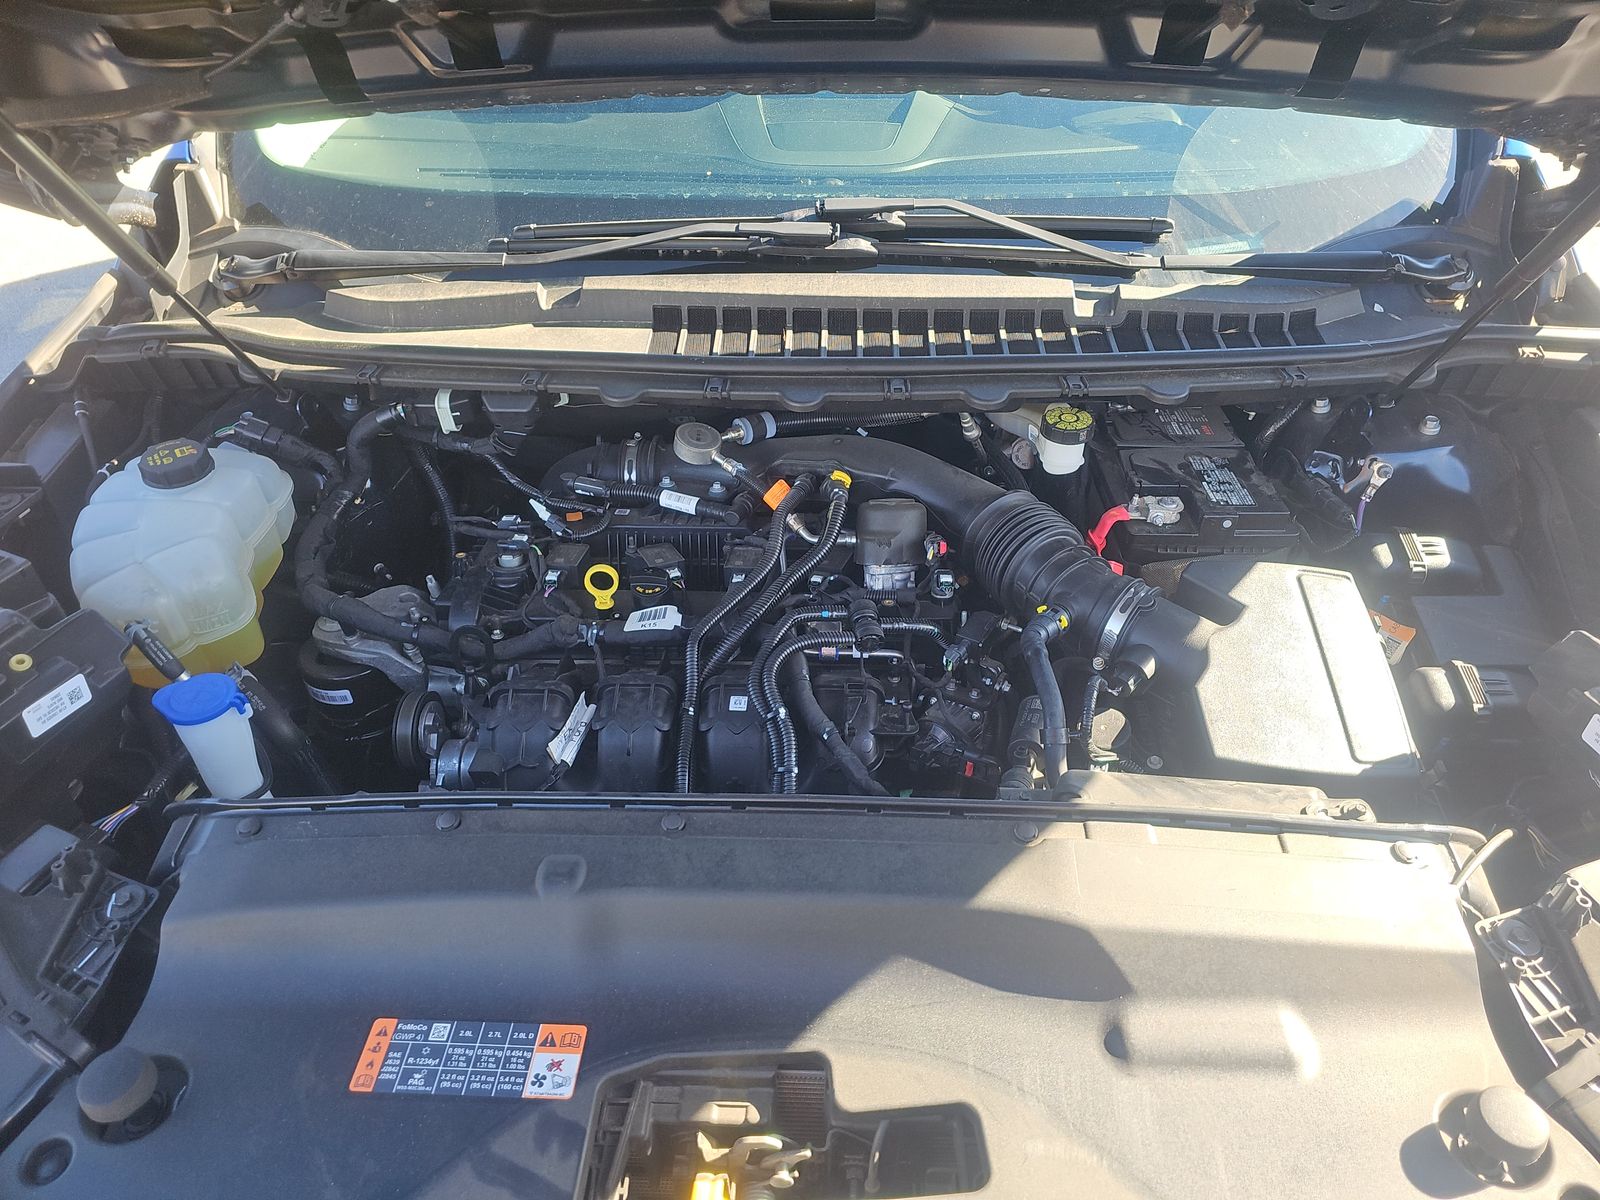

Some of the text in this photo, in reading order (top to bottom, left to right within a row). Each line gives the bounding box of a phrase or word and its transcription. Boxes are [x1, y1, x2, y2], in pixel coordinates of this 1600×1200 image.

[397, 1023, 428, 1031] FoMoCo
[392, 1032, 425, 1041] (GWP 4)
[466, 1048, 474, 1056] kg
[476, 1048, 494, 1056] 0.595
[406, 1057, 440, 1066] R-1234yf
[407, 1078, 425, 1086] PAG
[440, 1081, 450, 1089] (95
[470, 1082, 480, 1090] (95
[497, 1083, 512, 1091] (160
